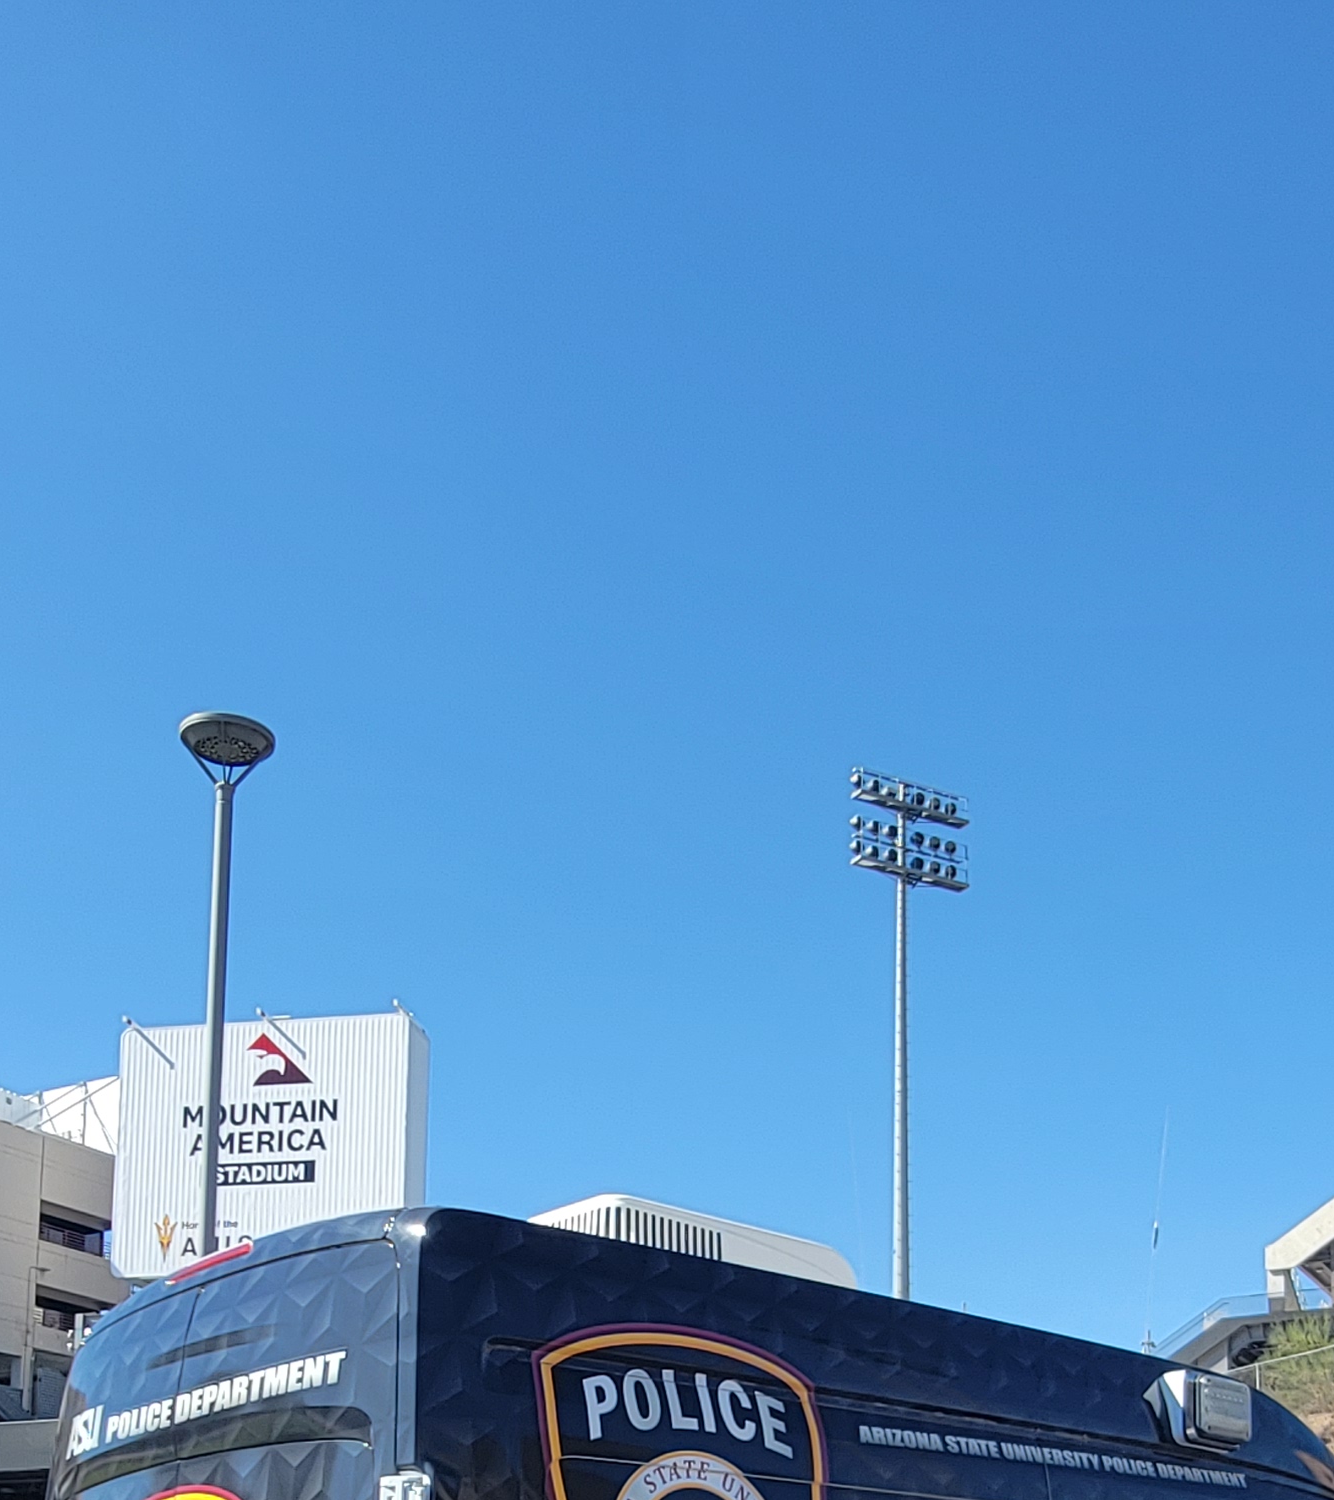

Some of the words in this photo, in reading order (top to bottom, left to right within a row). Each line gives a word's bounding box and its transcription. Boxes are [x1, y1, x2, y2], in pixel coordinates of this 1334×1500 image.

[216, 1163, 305, 1184] STADIUM
[66, 1404, 105, 1460] ASU
[105, 1398, 172, 1444] POLICE
[174, 1350, 348, 1425] DEPARTMENT
[582, 1368, 794, 1460] POLICE
[643, 1459, 711, 1494] STATE
[858, 1425, 944, 1452] ARIZONA
[944, 1435, 1001, 1459] STATE
[1000, 1442, 1100, 1472] UNIVERSITY
[1101, 1455, 1157, 1479] POLICE
[1155, 1462, 1248, 1489] DEPARTMENT
